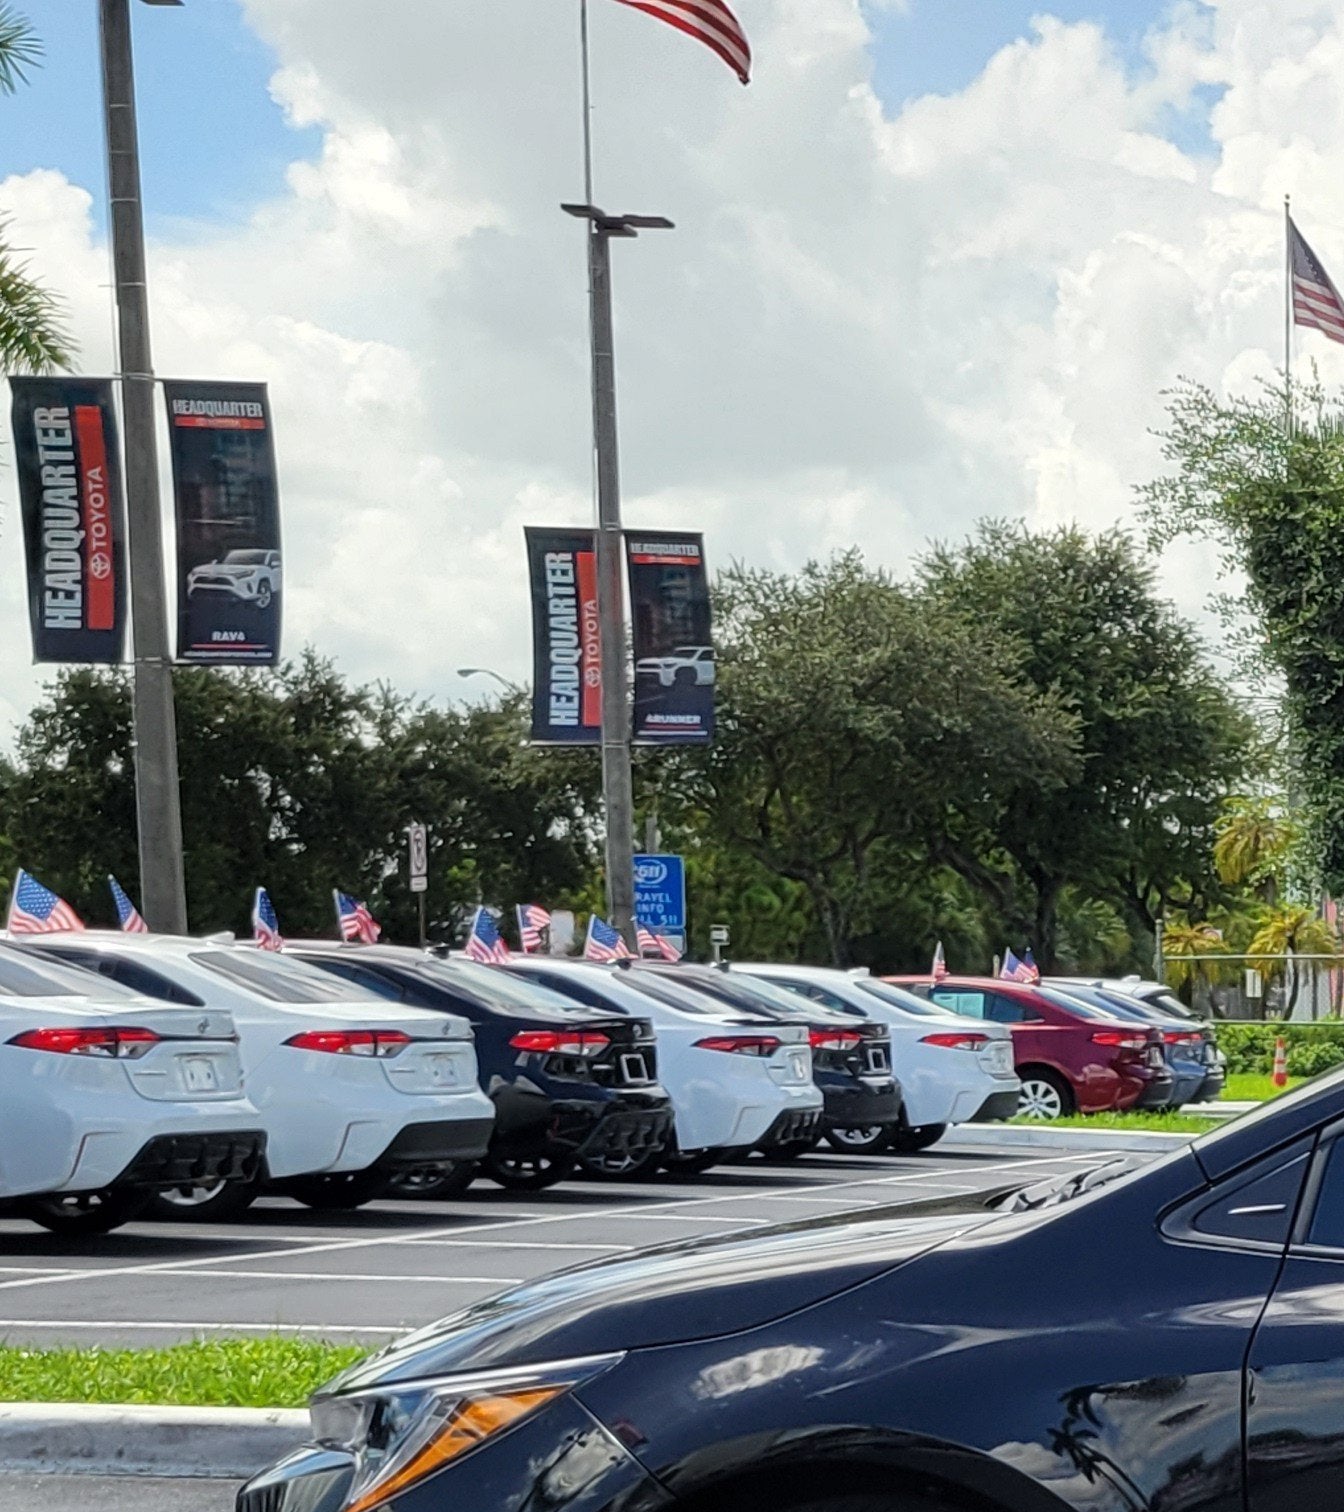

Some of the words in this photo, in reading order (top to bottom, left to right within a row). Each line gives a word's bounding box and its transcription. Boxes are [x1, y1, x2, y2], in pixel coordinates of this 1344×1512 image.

[172, 399, 263, 417] HEADQUARTER
[34, 406, 84, 630] HEADQUARTER
[90, 466, 108, 548] TOYOTA
[211, 630, 246, 641] RAV4
[544, 551, 582, 727] HEADQUARTER
[583, 599, 600, 663] TOYOTA
[634, 892, 673, 903] RAVEL
